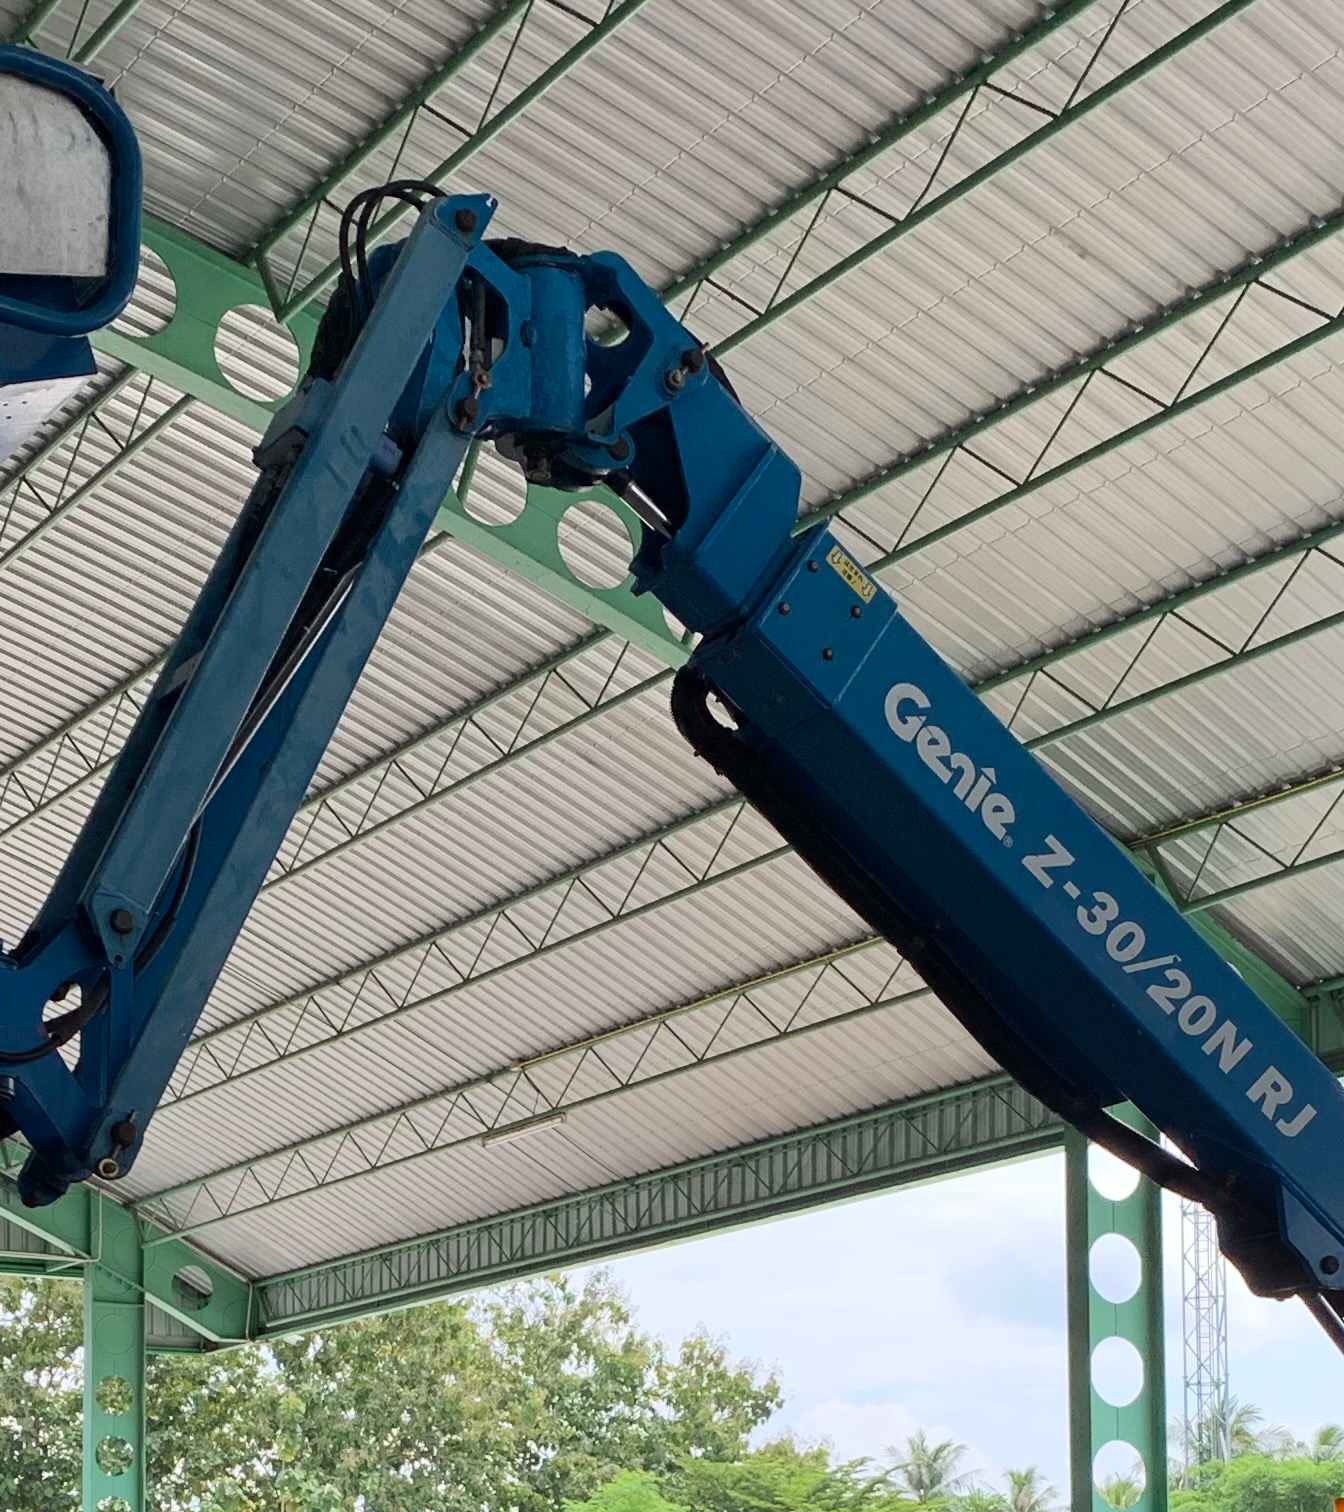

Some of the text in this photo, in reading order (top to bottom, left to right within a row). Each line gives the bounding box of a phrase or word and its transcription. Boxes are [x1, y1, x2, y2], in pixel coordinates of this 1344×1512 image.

[884, 682, 1317, 1138] Genie Z-30/20N RJ
